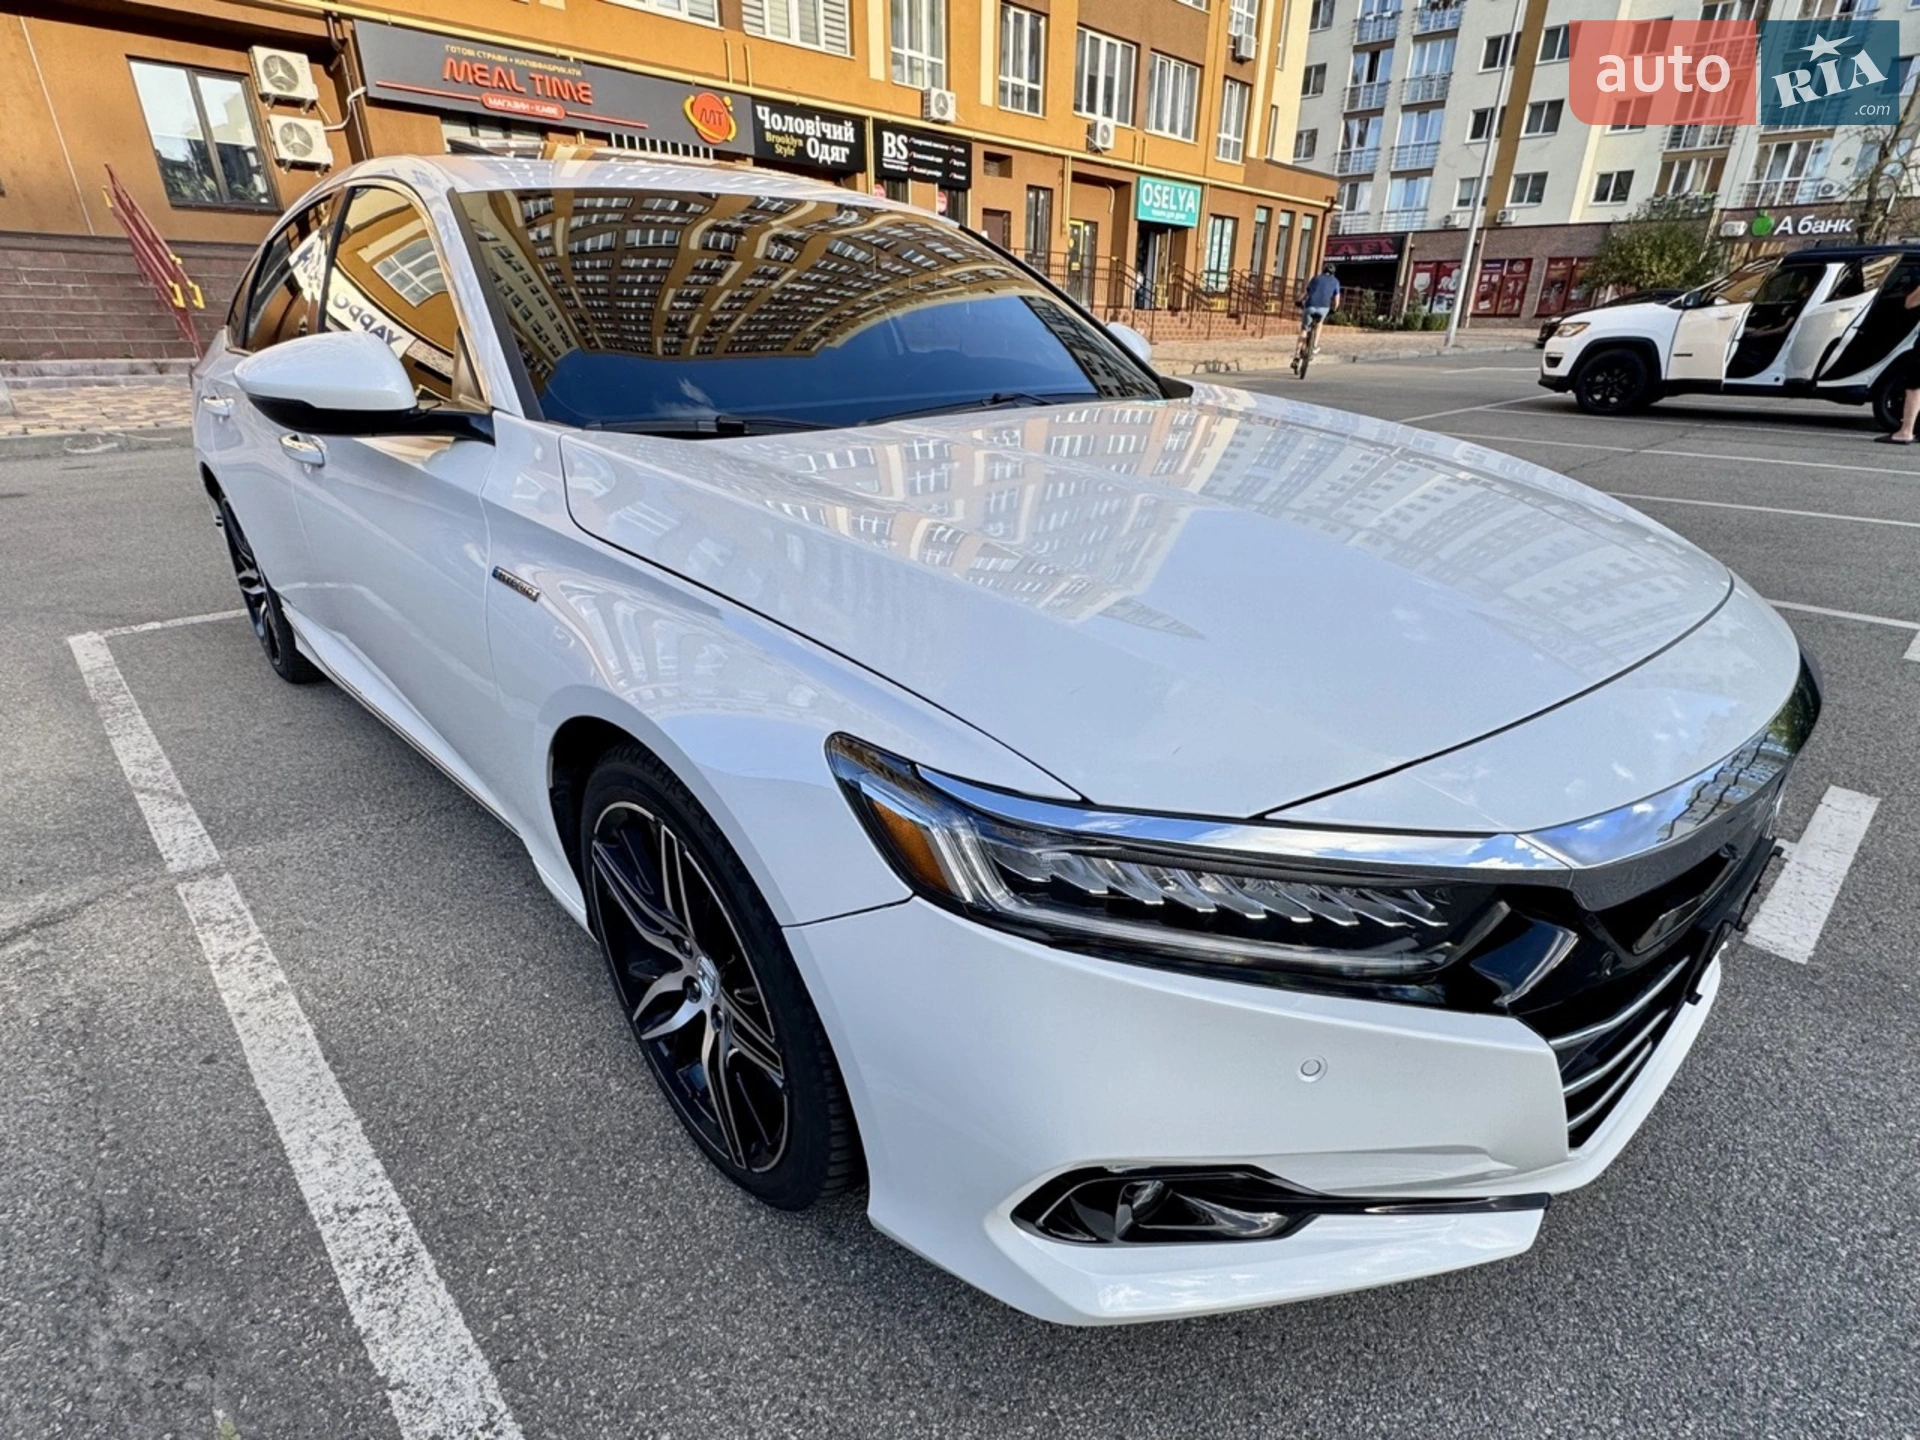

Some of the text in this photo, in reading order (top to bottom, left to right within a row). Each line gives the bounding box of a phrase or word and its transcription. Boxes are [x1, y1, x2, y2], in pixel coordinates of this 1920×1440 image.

[443, 57, 593, 105] MEAL TIME
[488, 97, 530, 112] МАГАЗИН
[755, 104, 856, 143] Чоловічий
[765, 131, 804, 148] Brooklyn
[774, 143, 796, 158] Style
[806, 136, 850, 165] Одяг
[882, 131, 909, 160] BS
[1142, 182, 1196, 214] OSELYA
[1797, 214, 1854, 235] банк
